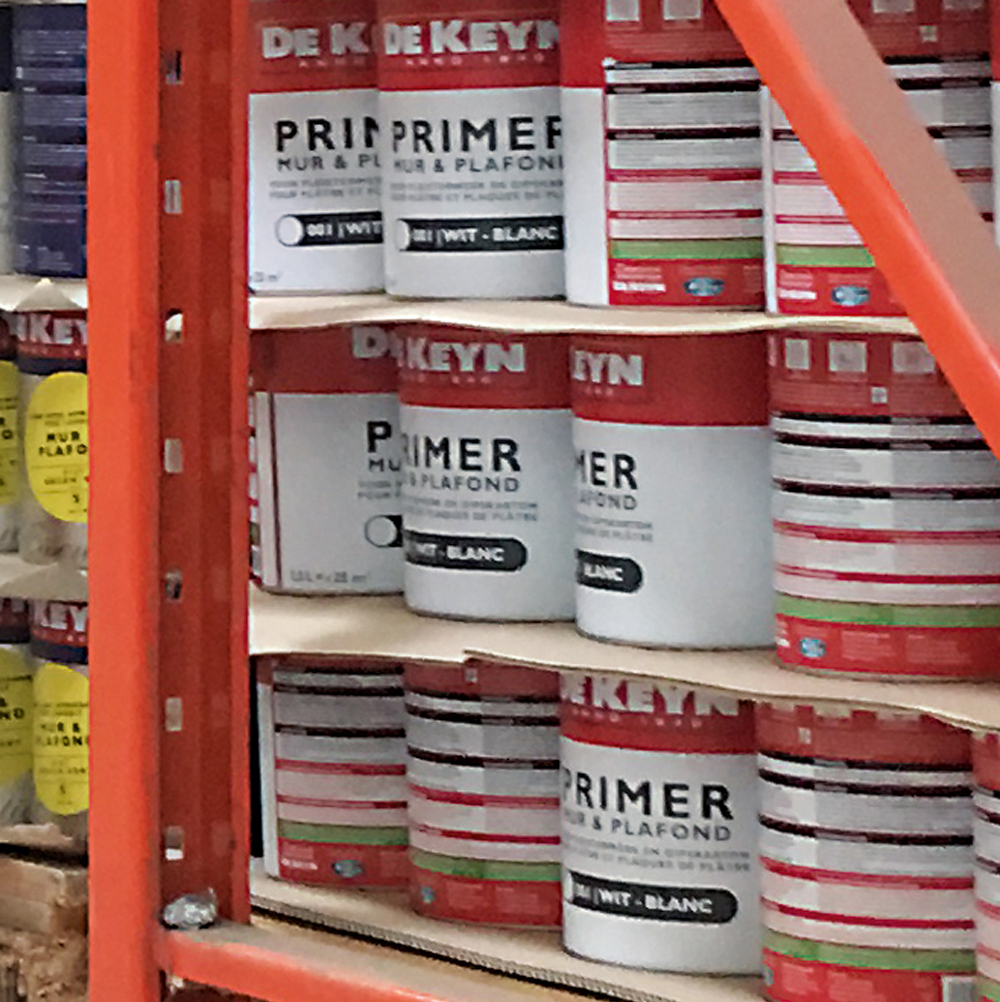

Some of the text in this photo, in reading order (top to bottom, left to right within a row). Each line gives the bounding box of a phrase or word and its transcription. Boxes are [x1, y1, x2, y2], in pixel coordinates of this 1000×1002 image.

[262, 27, 320, 58] DE
[404, 336, 525, 373] KEYN
[420, 475, 520, 494] PLAFOND
[611, 817, 732, 842] PLAFOND
[644, 892, 714, 915] BLANC
